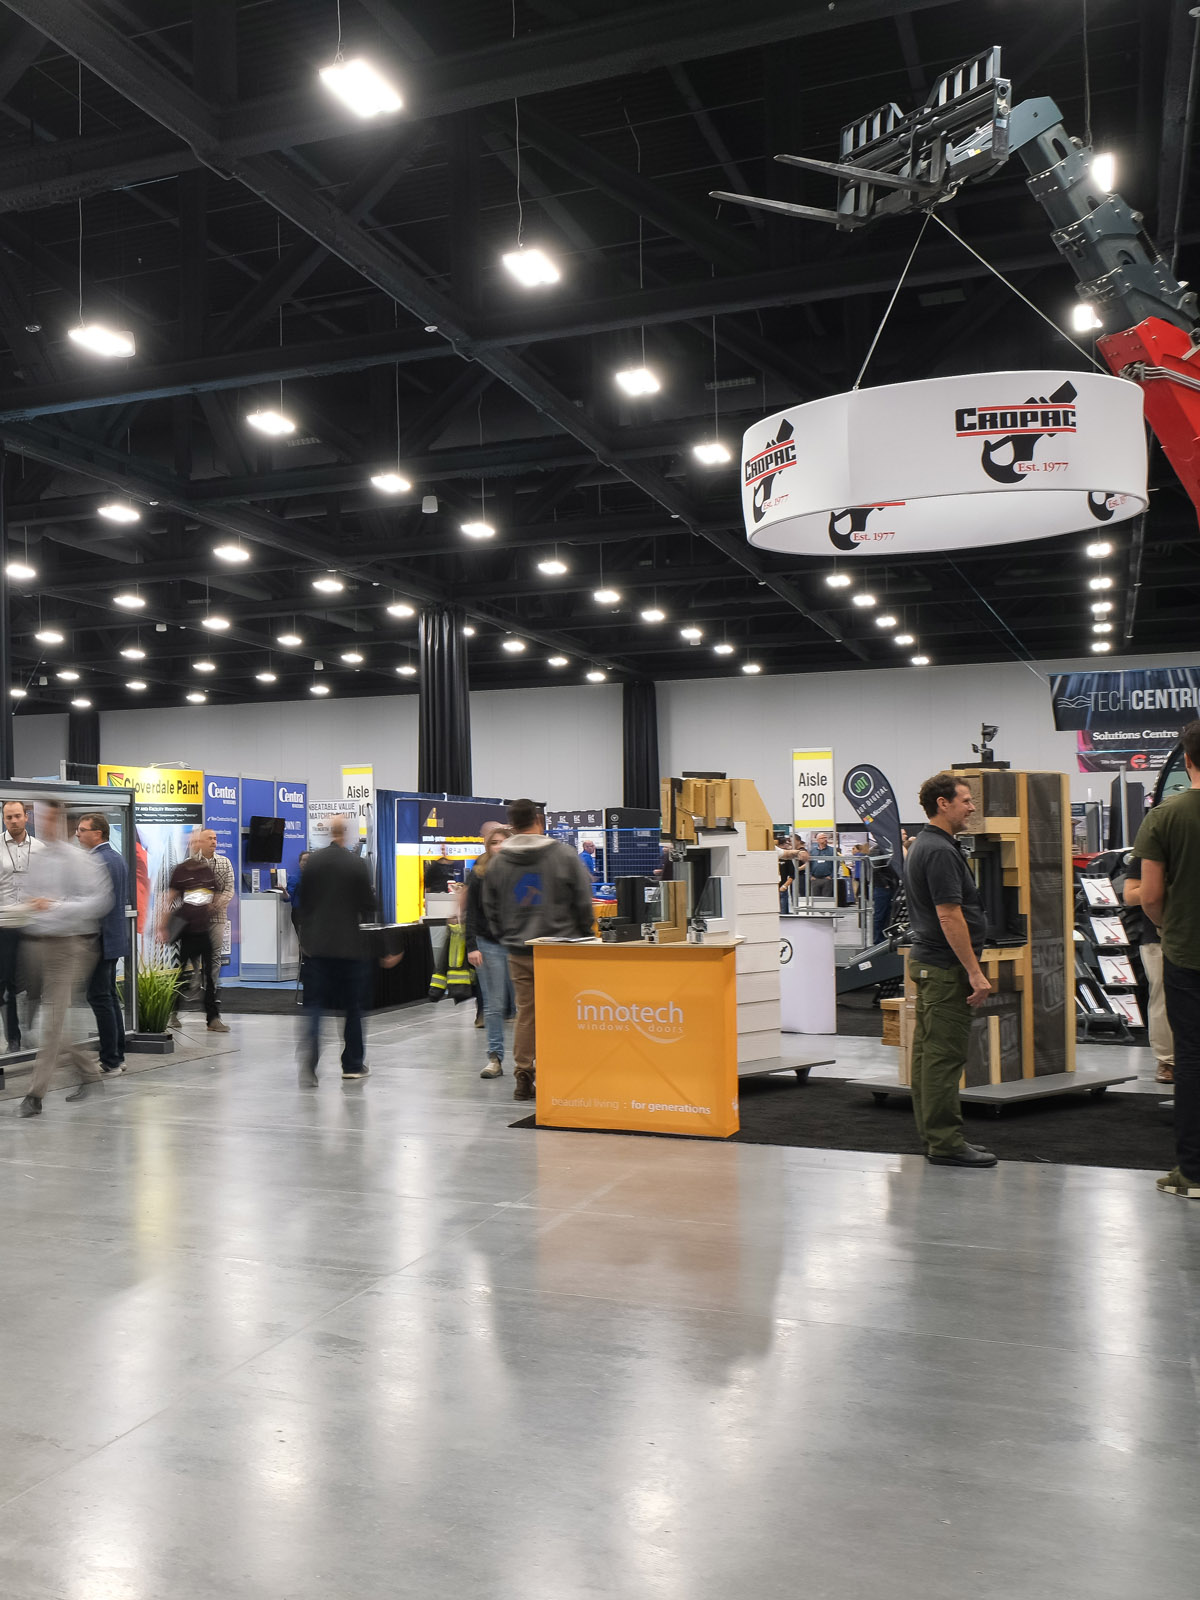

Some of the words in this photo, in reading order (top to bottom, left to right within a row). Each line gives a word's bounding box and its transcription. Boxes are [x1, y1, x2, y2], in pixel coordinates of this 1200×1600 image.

[955, 407, 1076, 432] CROPAC
[745, 444, 797, 482] CROPAC
[1017, 463, 1040, 472] Est.
[1042, 462, 1069, 472] 1977
[853, 532, 871, 541] Est.
[873, 531, 895, 541] 1977
[1087, 687, 1200, 712] TECHCENTRI
[1092, 731, 1141, 741] Solutions
[1142, 729, 1179, 739] Centre
[123, 778, 175, 794] Cloverdale
[176, 780, 199, 795] Paint
[798, 772, 828, 787] Aisle
[854, 776, 869, 793] JOT
[207, 782, 237, 799] Centra
[279, 787, 304, 803] Centra
[347, 785, 370, 798] Aisle
[865, 785, 888, 807] DIGITAL
[309, 803, 337, 811] NBEATABLE
[338, 802, 355, 811] VALUE
[801, 793, 825, 808] 200
[577, 1000, 684, 1024] innotech
[577, 1023, 631, 1032] windows
[648, 1024, 684, 1033] doors
[551, 1098, 592, 1108] beautiful
[593, 1098, 620, 1110] living
[631, 1100, 646, 1110] for
[647, 1101, 712, 1115] generations
